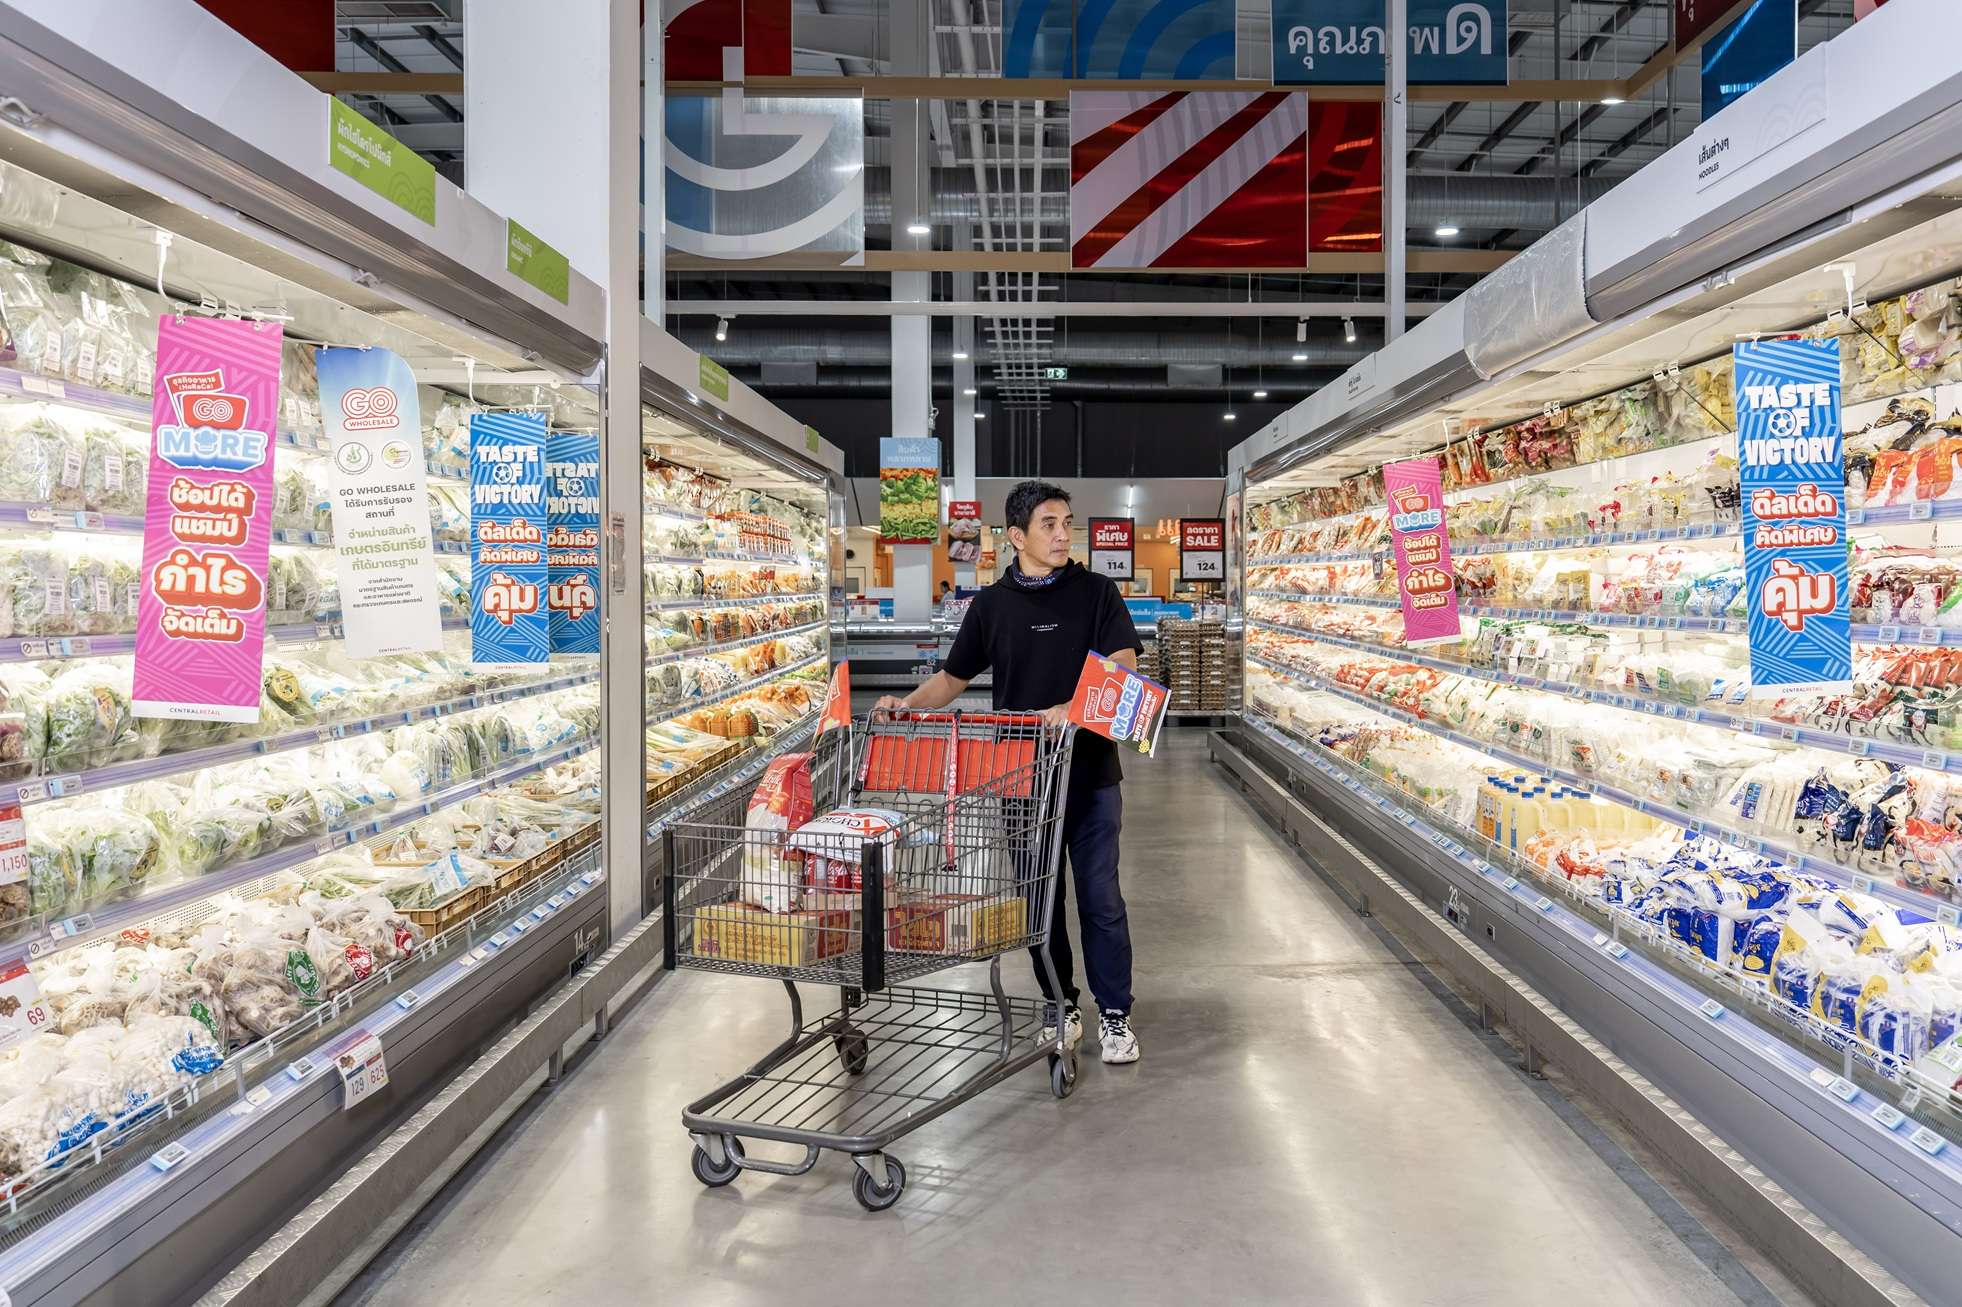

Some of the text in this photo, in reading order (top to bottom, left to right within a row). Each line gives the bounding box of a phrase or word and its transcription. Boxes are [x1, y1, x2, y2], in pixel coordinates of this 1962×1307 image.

[342, 387, 397, 419] GO
[1745, 383, 1831, 409] TASTE
[193, 398, 233, 422] GO
[349, 418, 395, 427] WHOLESALE
[1768, 408, 1810, 437] OF
[163, 428, 263, 459] MORE
[1744, 437, 1835, 466] VICTORY
[476, 445, 539, 463] TASTE
[492, 462, 523, 484] OF
[172, 479, 248, 508] ช้อปได้
[339, 483, 416, 496] GO WHOLESALE
[474, 484, 542, 504] VICTORY
[344, 497, 413, 508] ได้รับการรับรอง
[1754, 486, 1833, 515] ดีลเด็ด
[365, 507, 395, 519] สถานที่
[1396, 511, 1439, 527] MORE
[348, 524, 416, 539] จำหน่ายสินค้า
[480, 518, 538, 540] ดีลเด็ด
[1096, 530, 1128, 541] พิเศษ
[1756, 526, 1833, 546] คัดพิเศษ
[340, 536, 427, 556] เกษตรอินทรีย์
[1186, 535, 1219, 546] SALE
[351, 557, 418, 571] ที่ได้มาตรฐาน
[480, 547, 538, 563] คัดพิเศษ
[159, 554, 247, 595] กำไร
[1107, 561, 1124, 570] 114
[1197, 562, 1215, 571] 124
[1407, 571, 1446, 591] กำไร
[484, 572, 535, 622] คุ้ม
[1763, 560, 1830, 627] คุ้ม
[161, 608, 238, 636] จัดเต็ม
[1113, 677, 1139, 737] MORE
[27, 1007, 45, 1025] 69
[352, 1065, 384, 1096] 129 625
